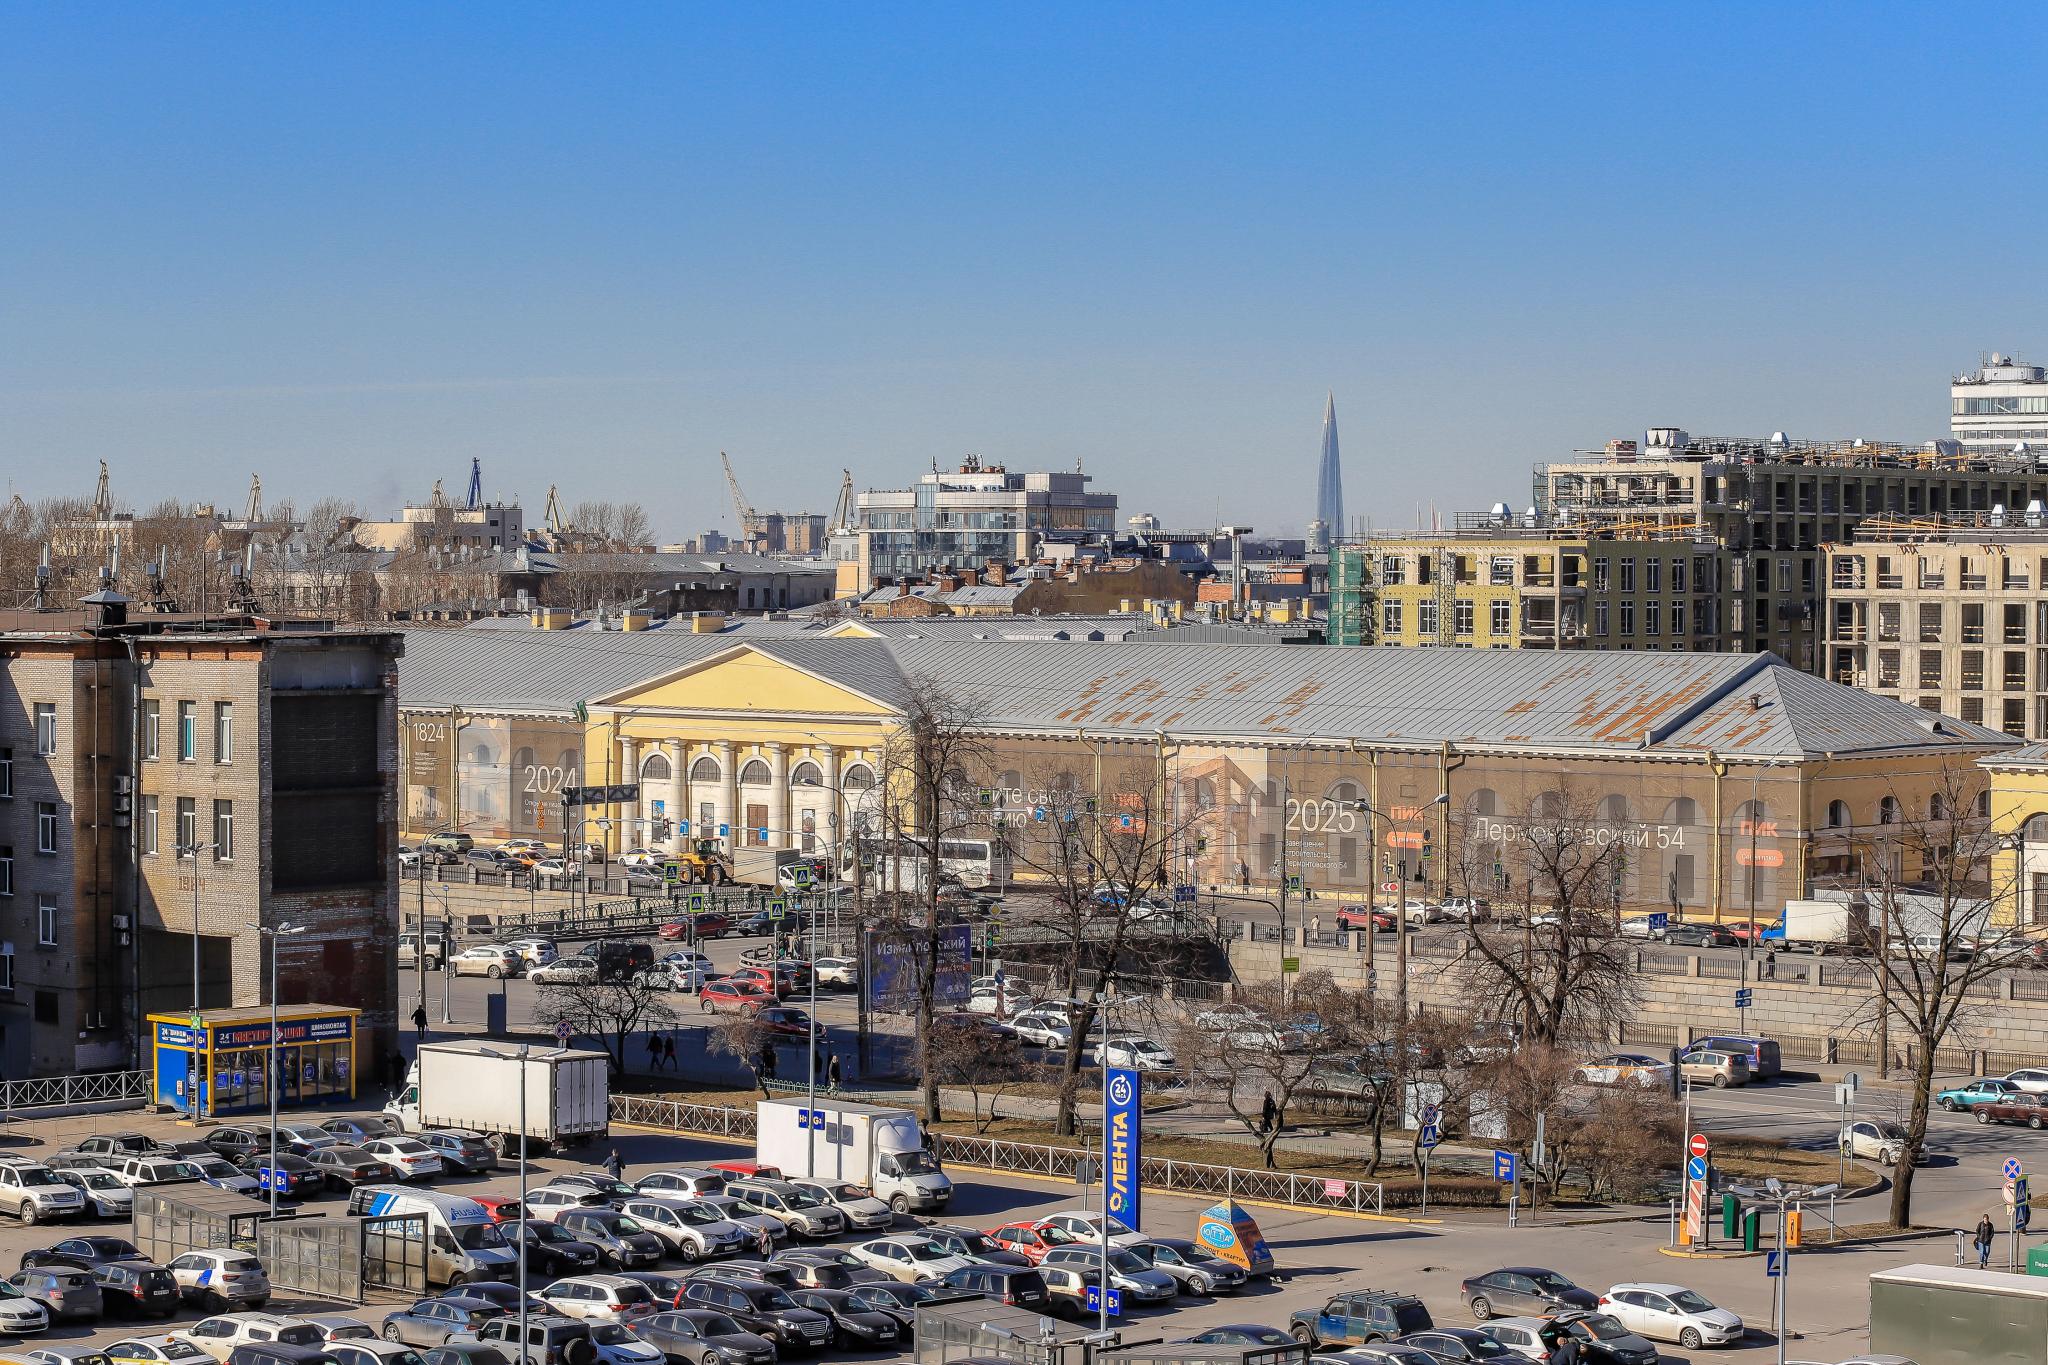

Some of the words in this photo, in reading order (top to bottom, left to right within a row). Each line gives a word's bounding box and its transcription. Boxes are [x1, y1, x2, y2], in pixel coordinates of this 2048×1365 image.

[413, 722, 445, 742] 1824
[524, 765, 576, 794] 2024
[1286, 798, 1356, 833] 2025
[1390, 806, 1424, 821] ПИК
[1656, 825, 1685, 849] 54
[1740, 820, 1779, 838] ПИК
[284, 1026, 305, 1039] ШИН
[1115, 1083, 1126, 1094] 24
[1112, 1111, 1128, 1194] ЛЕНТА
[454, 1207, 486, 1217] RUSAL
[1089, 1293, 1099, 1305] F3
[1108, 1296, 1118, 1308] E3
